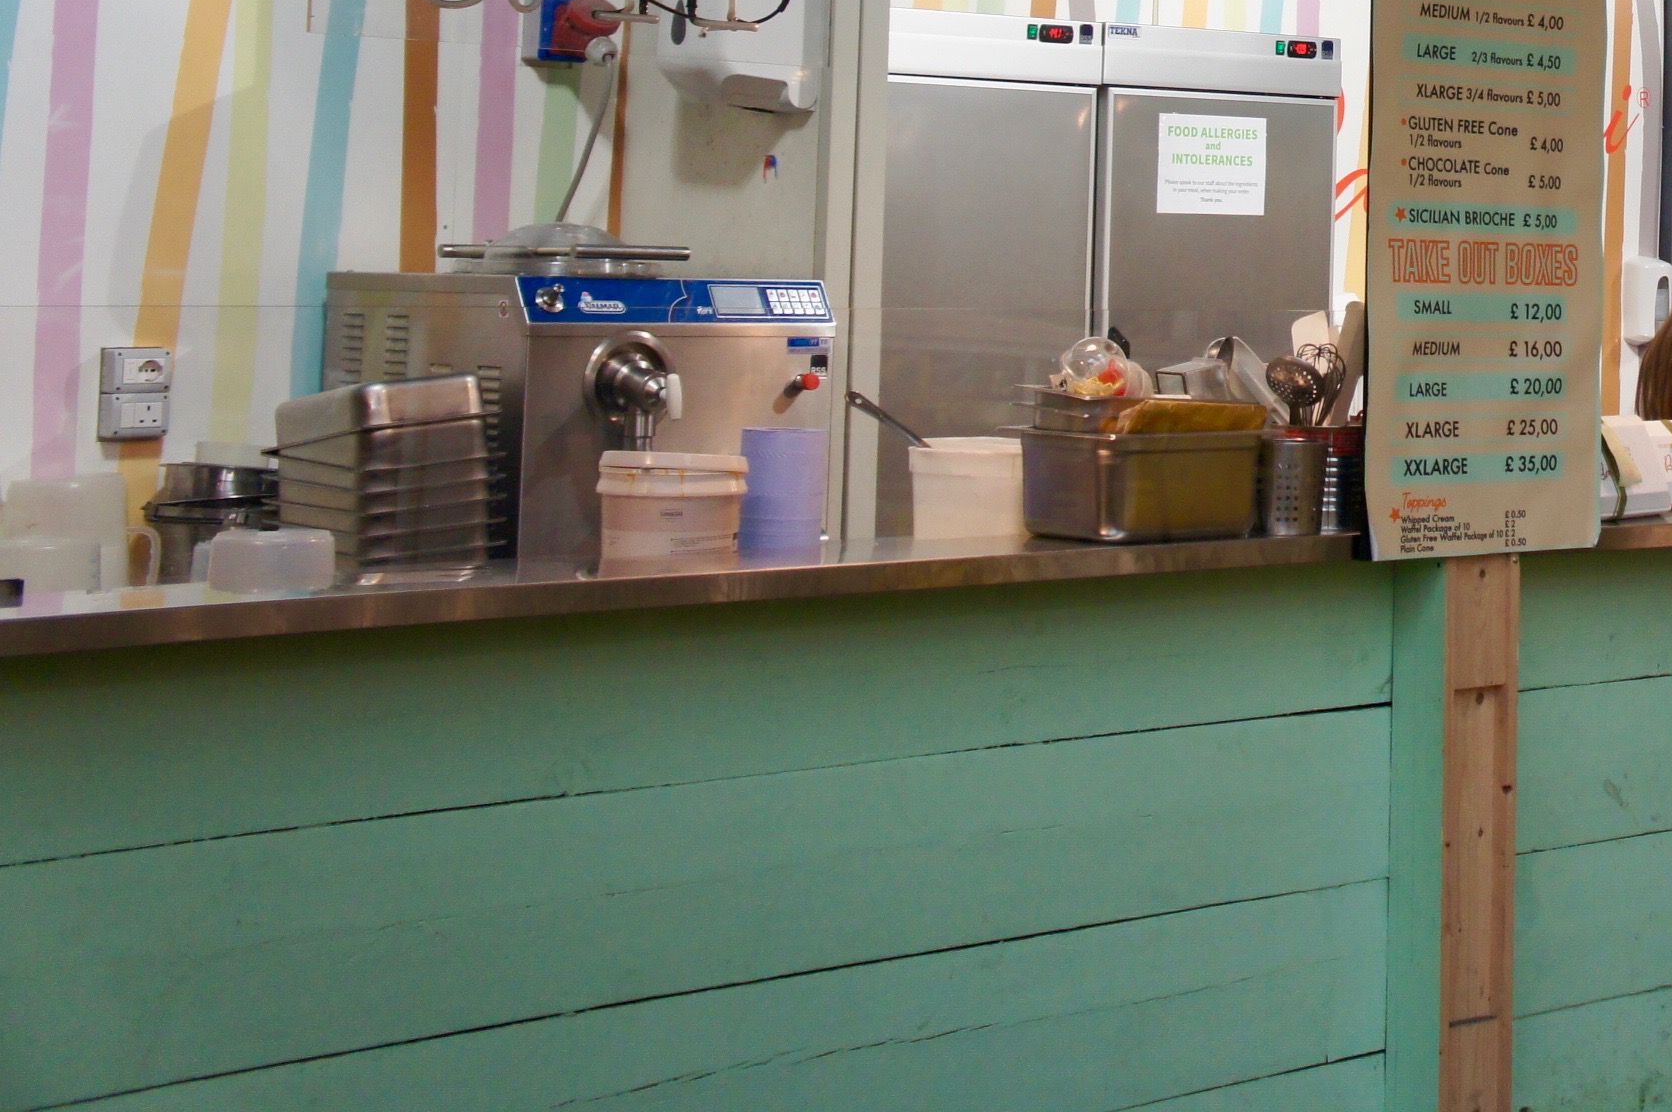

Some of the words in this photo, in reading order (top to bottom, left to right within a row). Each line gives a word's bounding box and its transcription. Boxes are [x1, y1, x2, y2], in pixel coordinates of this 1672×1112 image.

[1420, 3, 1470, 21] MEDIUM
[1475, 11, 1490, 24] 1/2
[1492, 13, 1524, 27] flavours
[1110, 26, 1138, 35] TEKNA
[1417, 43, 1456, 61] LARGE
[1472, 51, 1488, 64] 2/3
[1490, 52, 1523, 66] flavours
[1416, 84, 1463, 101] XLARGE
[1466, 88, 1484, 101] 3/4
[1487, 89, 1523, 104] flavours
[1167, 125, 1198, 137] FOOD
[1201, 127, 1258, 140] ALLERGIES
[1408, 116, 1454, 132] GLUTEN
[1457, 118, 1484, 134] FREE
[1488, 121, 1518, 137] Cone
[1205, 141, 1221, 150] and
[1409, 135, 1425, 147] 1/2
[1427, 135, 1462, 149] flavours
[1172, 153, 1253, 166] INTOLERANCES
[1408, 157, 1480, 175] CHOCOLATE
[1484, 163, 1510, 176] Cone
[1409, 174, 1425, 187] 1/2
[1428, 175, 1462, 188] flavours
[1409, 208, 1460, 225] SICILIAN
[1465, 210, 1515, 228] BRIOCHE
[1388, 238, 1451, 284] TAKE
[1458, 241, 1499, 285] OUT
[1505, 241, 1579, 286] BOXES
[1414, 300, 1452, 315] SMALL
[1524, 303, 1562, 323] 12,00
[1412, 341, 1460, 356] MEDIUM
[1523, 340, 1562, 360] 16,00
[1409, 382, 1447, 397] LARGE
[1523, 378, 1563, 397] 20,00
[1406, 421, 1460, 439] XLARGE
[1519, 419, 1558, 437] 25,00
[1404, 457, 1468, 476] XXLARGE
[1518, 455, 1557, 474] 35,00
[1401, 514, 1430, 524] Whipped
[1432, 514, 1455, 522] Cream
[1423, 525, 1452, 534] Package
[1454, 523, 1461, 531] of
[1463, 523, 1470, 531] 10
[1401, 535, 1421, 544] Gluten
[1423, 533, 1437, 542] Free
[1464, 532, 1487, 541] Package
[1489, 530, 1495, 538] of
[1401, 545, 1415, 553] Plain
[1417, 544, 1434, 552] Cone
